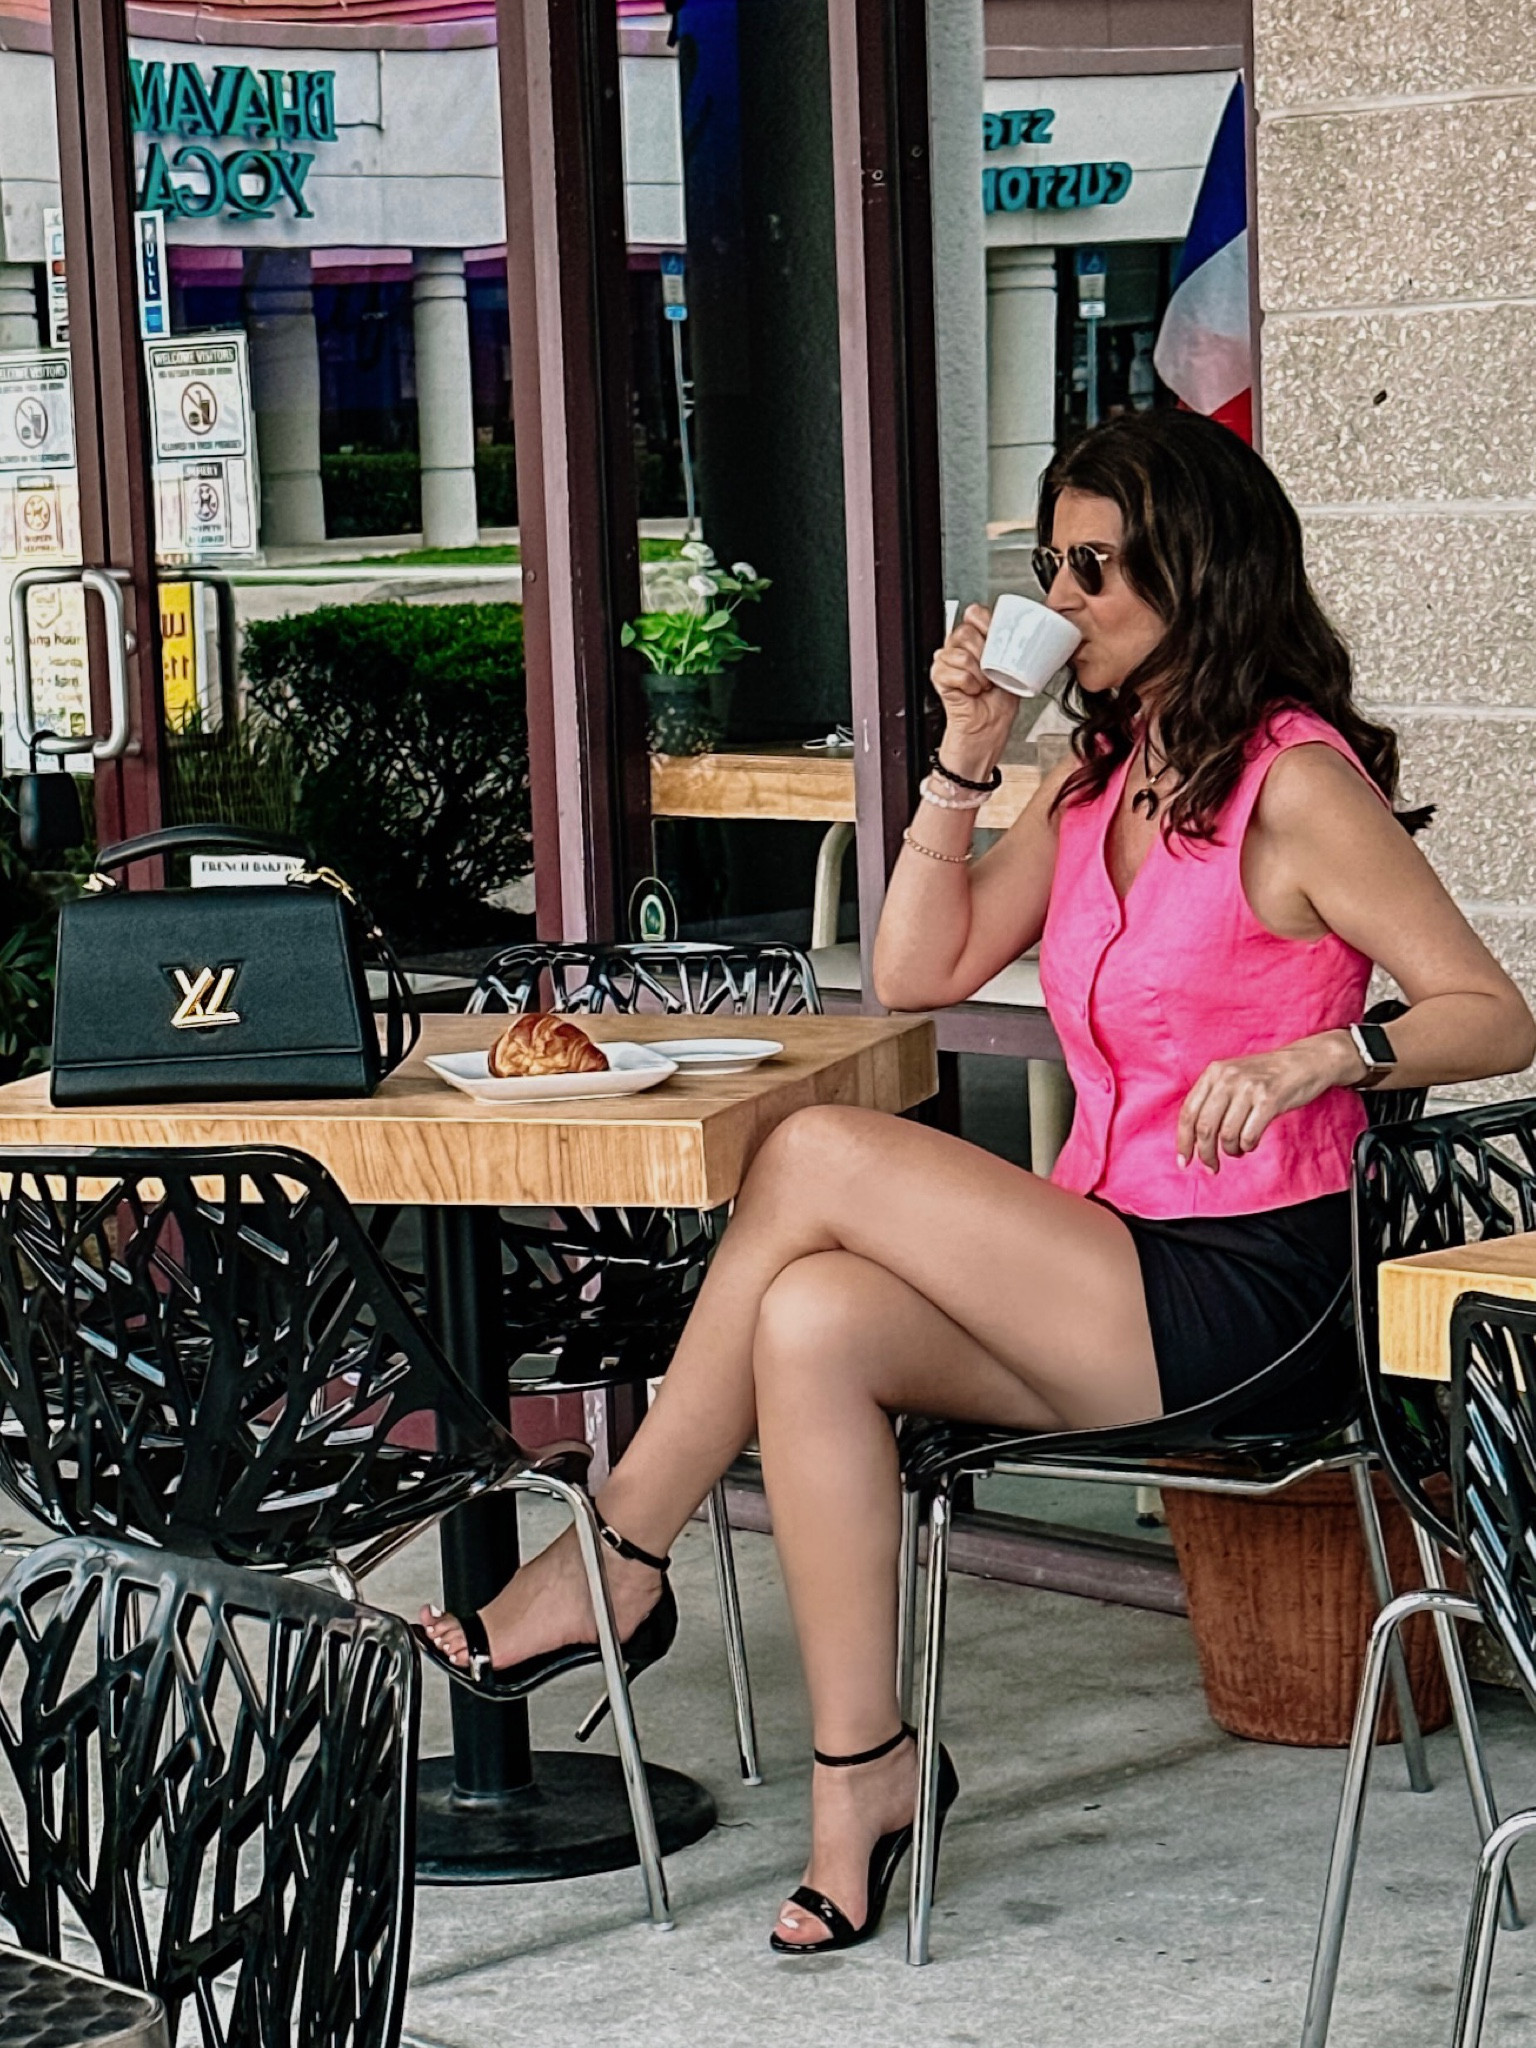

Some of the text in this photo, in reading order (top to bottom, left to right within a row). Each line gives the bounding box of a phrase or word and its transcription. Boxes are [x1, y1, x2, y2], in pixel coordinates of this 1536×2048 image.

[144, 222, 158, 296] PULL
[154, 348, 235, 367] WELCOME VISITORS
[55, 633, 84, 646] hour
[202, 861, 249, 873] FRENCH
